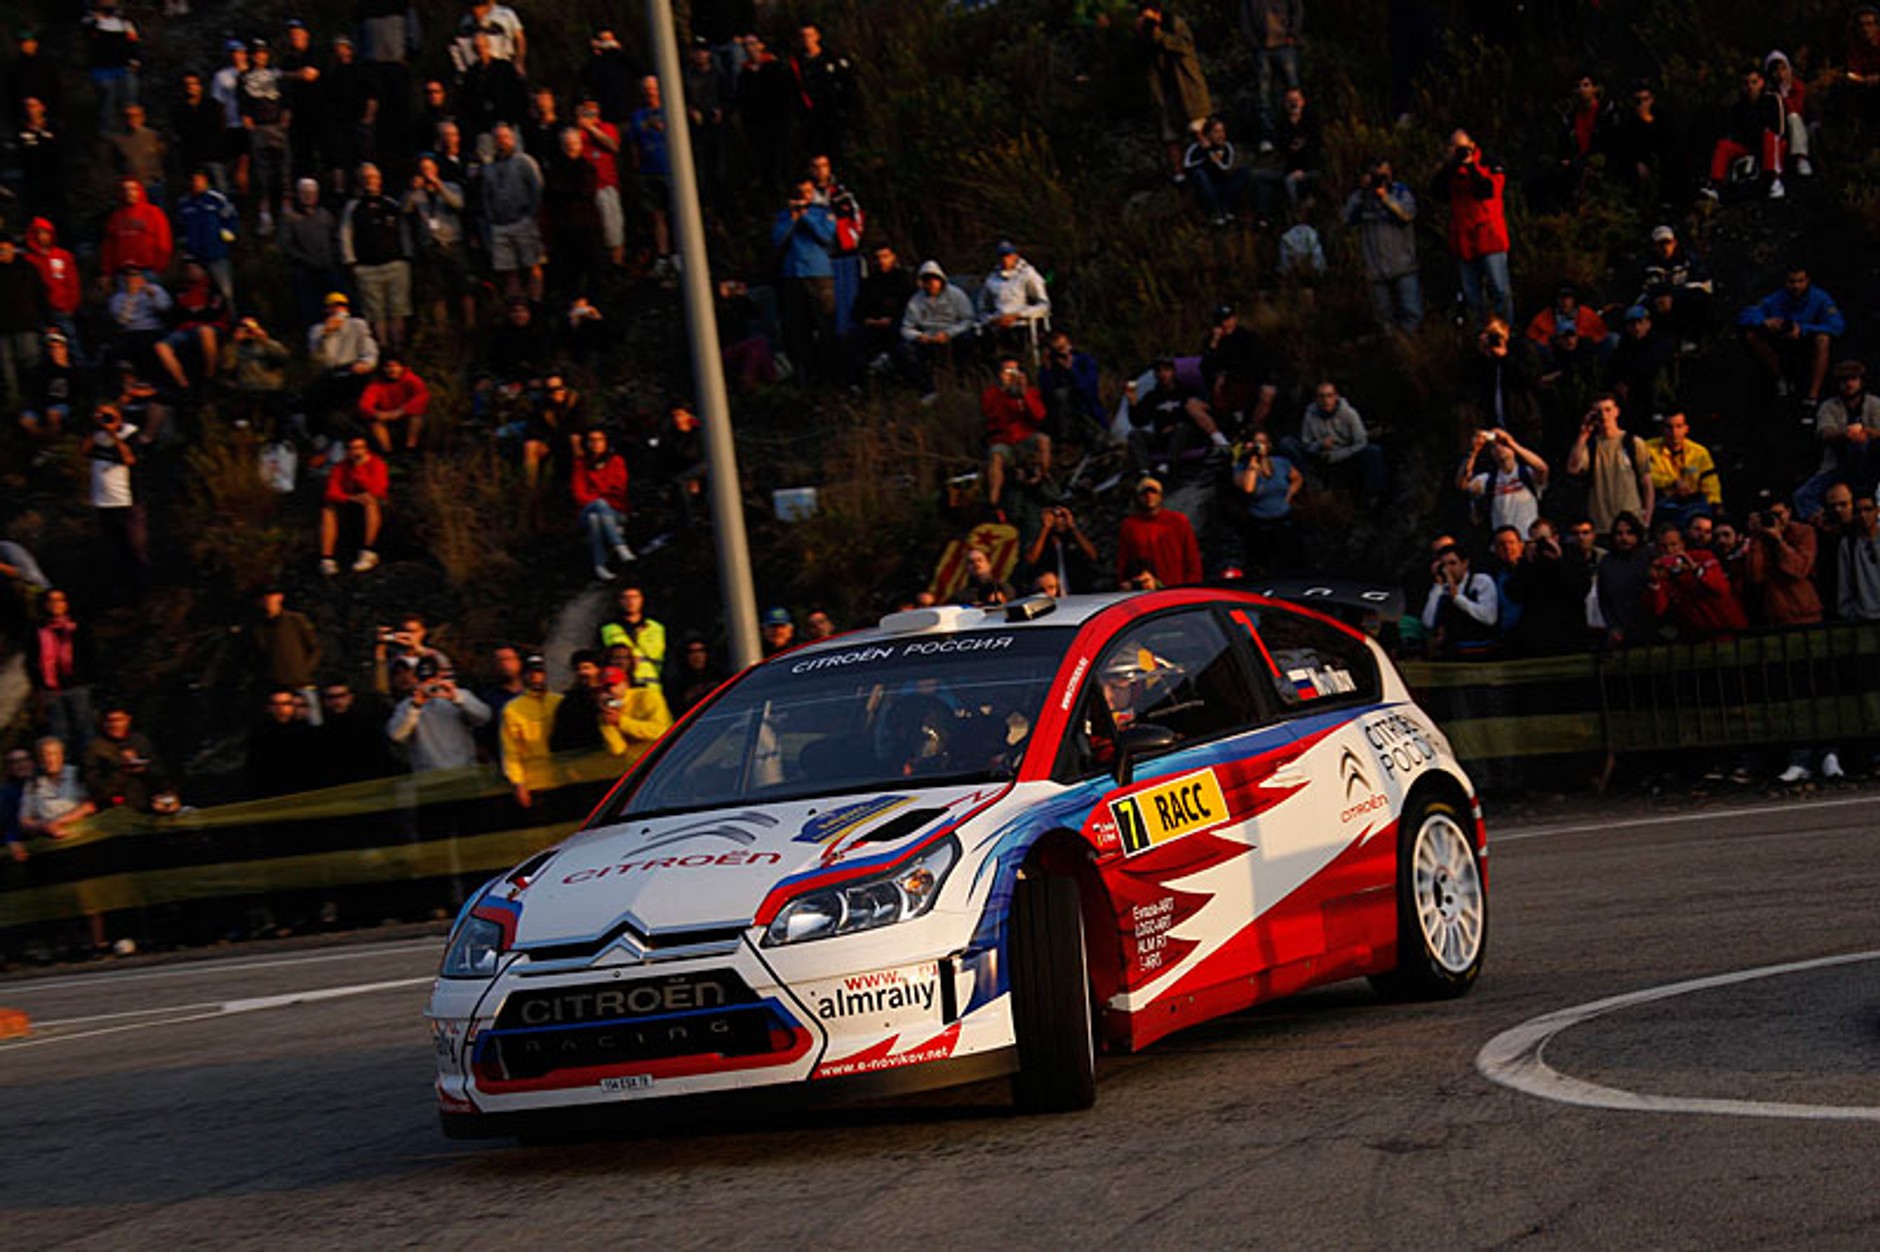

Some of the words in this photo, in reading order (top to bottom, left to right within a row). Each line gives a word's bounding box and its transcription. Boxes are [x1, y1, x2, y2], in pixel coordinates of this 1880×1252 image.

[791, 646, 894, 674] CITROËN
[903, 636, 1014, 655] РОССИЯ
[1118, 800, 1140, 850] 7
[1153, 782, 1212, 832] RACC
[818, 979, 935, 1019] almrally
[819, 1046, 949, 1076] www.e-novikov.net
